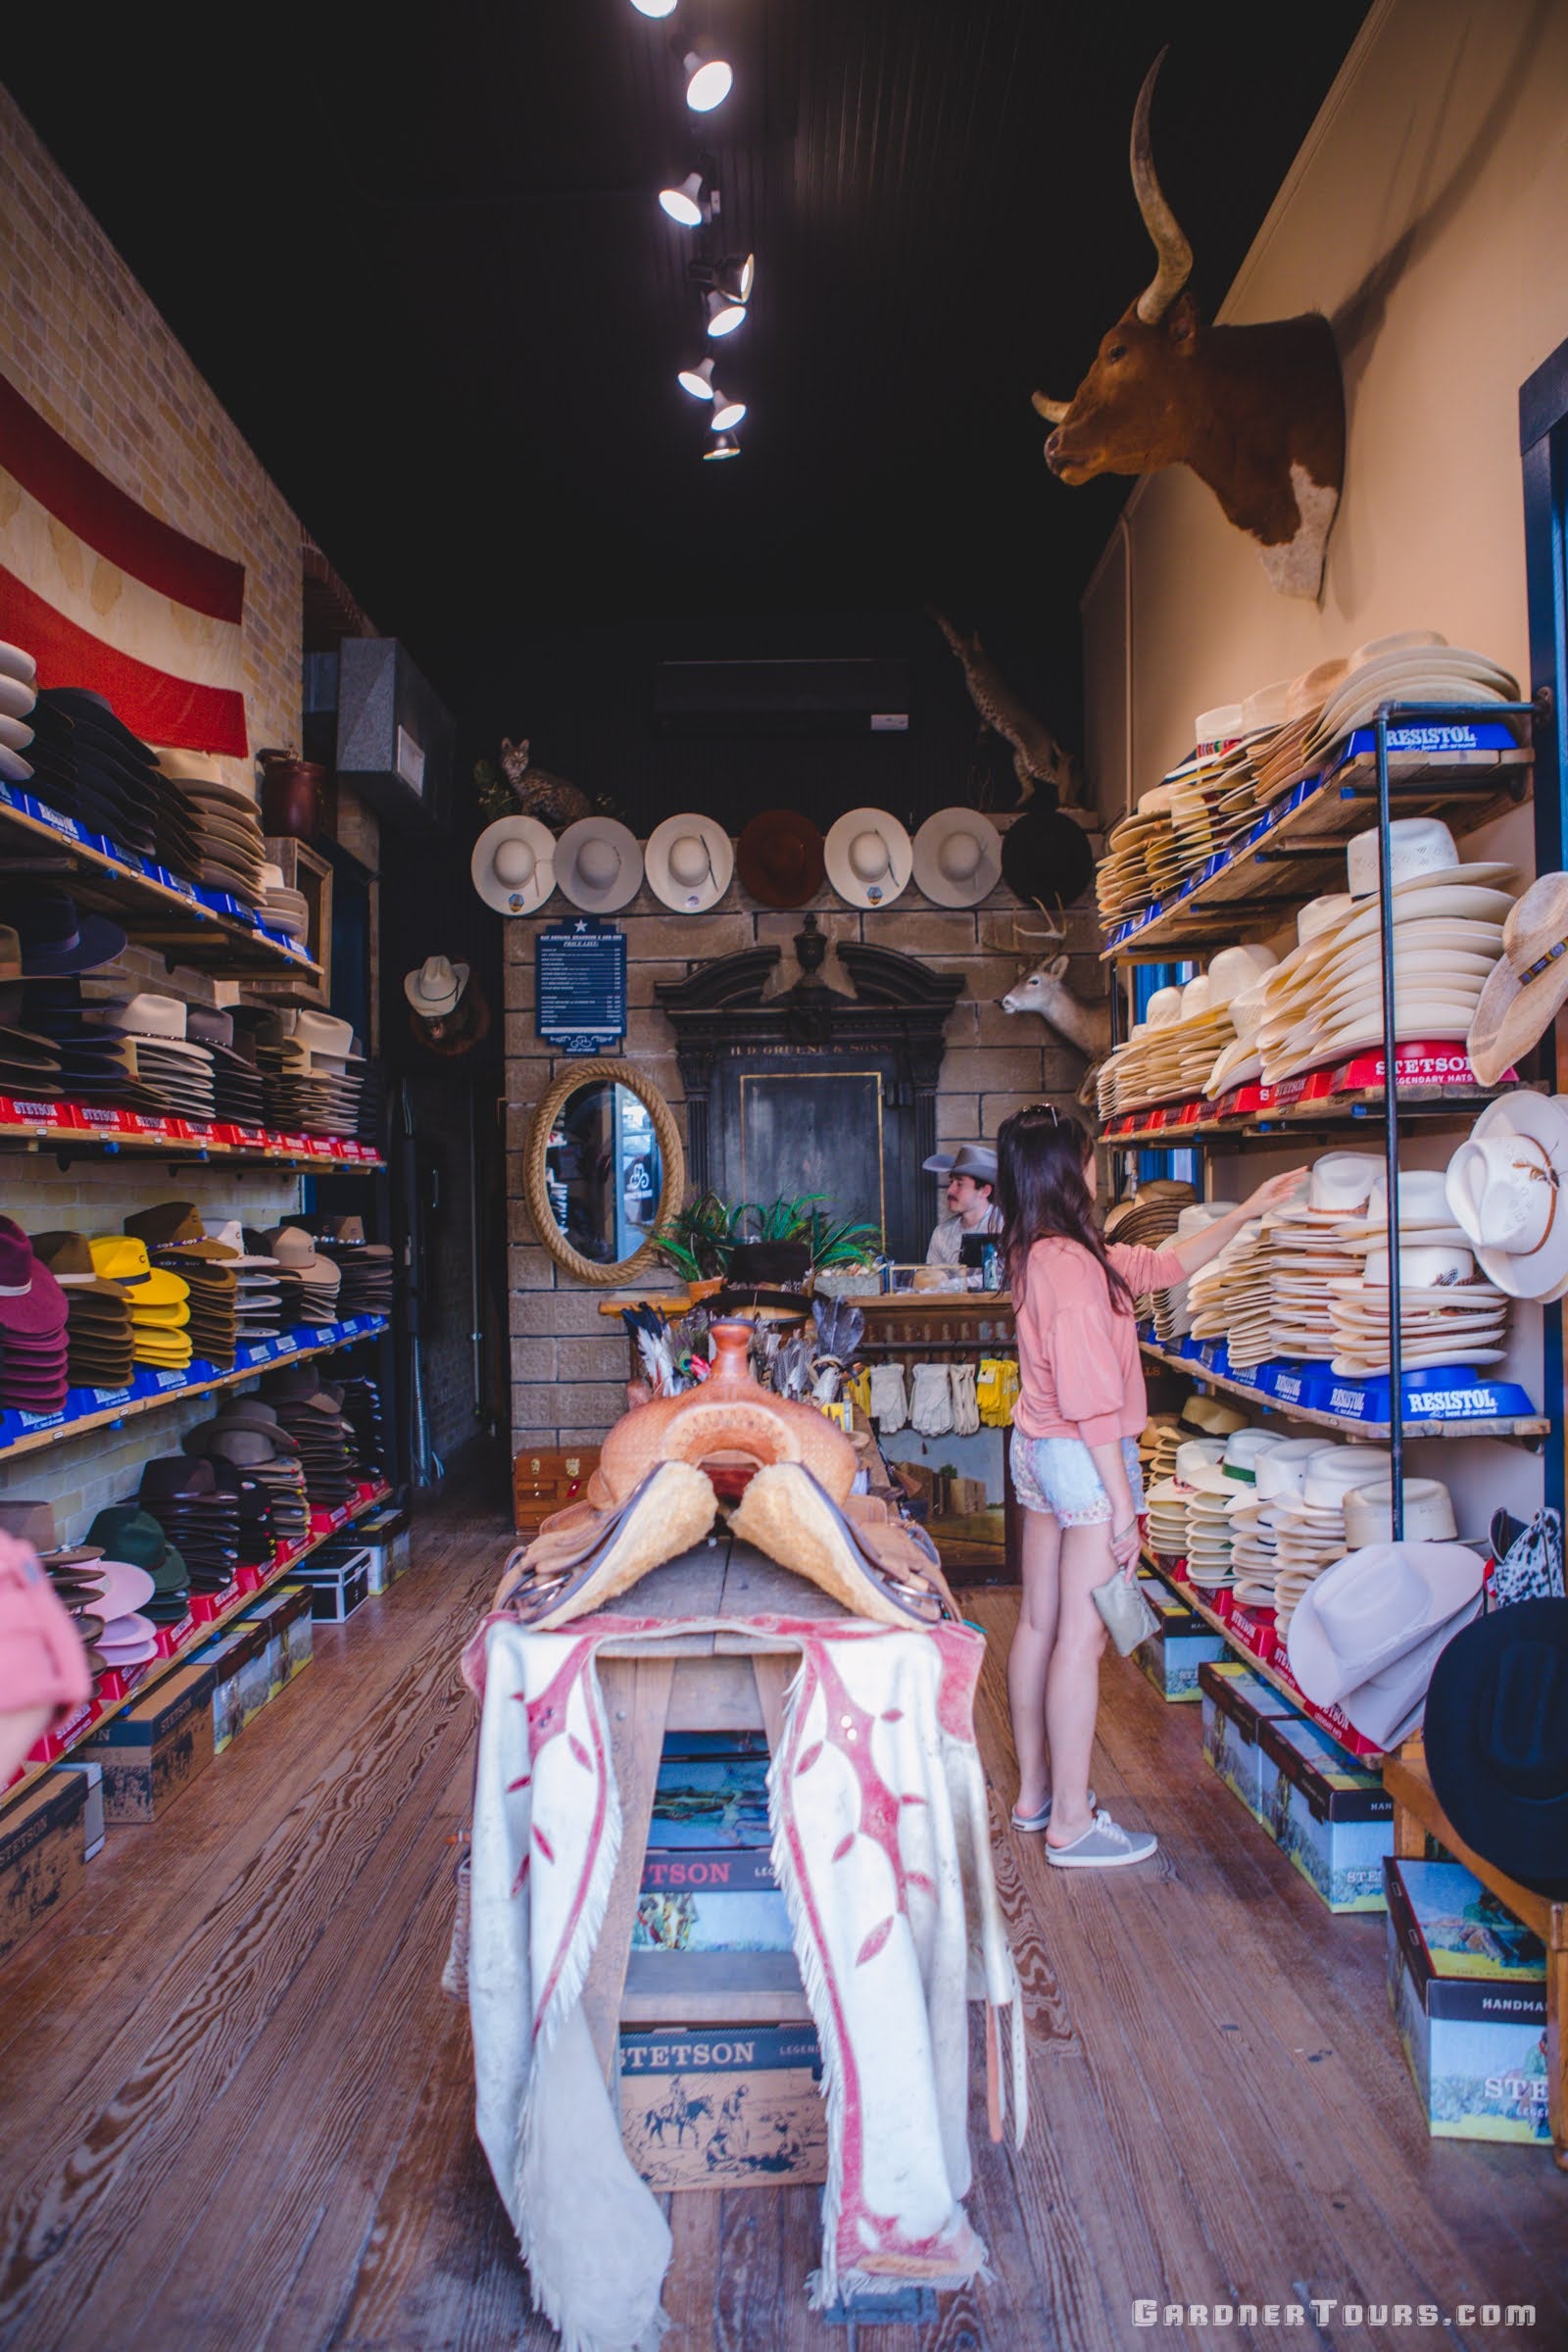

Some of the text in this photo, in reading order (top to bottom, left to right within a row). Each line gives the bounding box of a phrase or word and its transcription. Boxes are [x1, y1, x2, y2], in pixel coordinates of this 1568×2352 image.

[1386, 725, 1477, 747] RESISTOL
[1375, 1056, 1471, 1076] STETSO
[1396, 1075, 1445, 1086] GENDARY
[13, 1101, 58, 1117] STETSON
[81, 1107, 120, 1123] STETSON
[1329, 1388, 1365, 1411] RESISTOL
[1407, 1388, 1498, 1413] RESISTOL
[1347, 1871, 1382, 1884] STE
[1482, 1998, 1547, 2012] HANDMA
